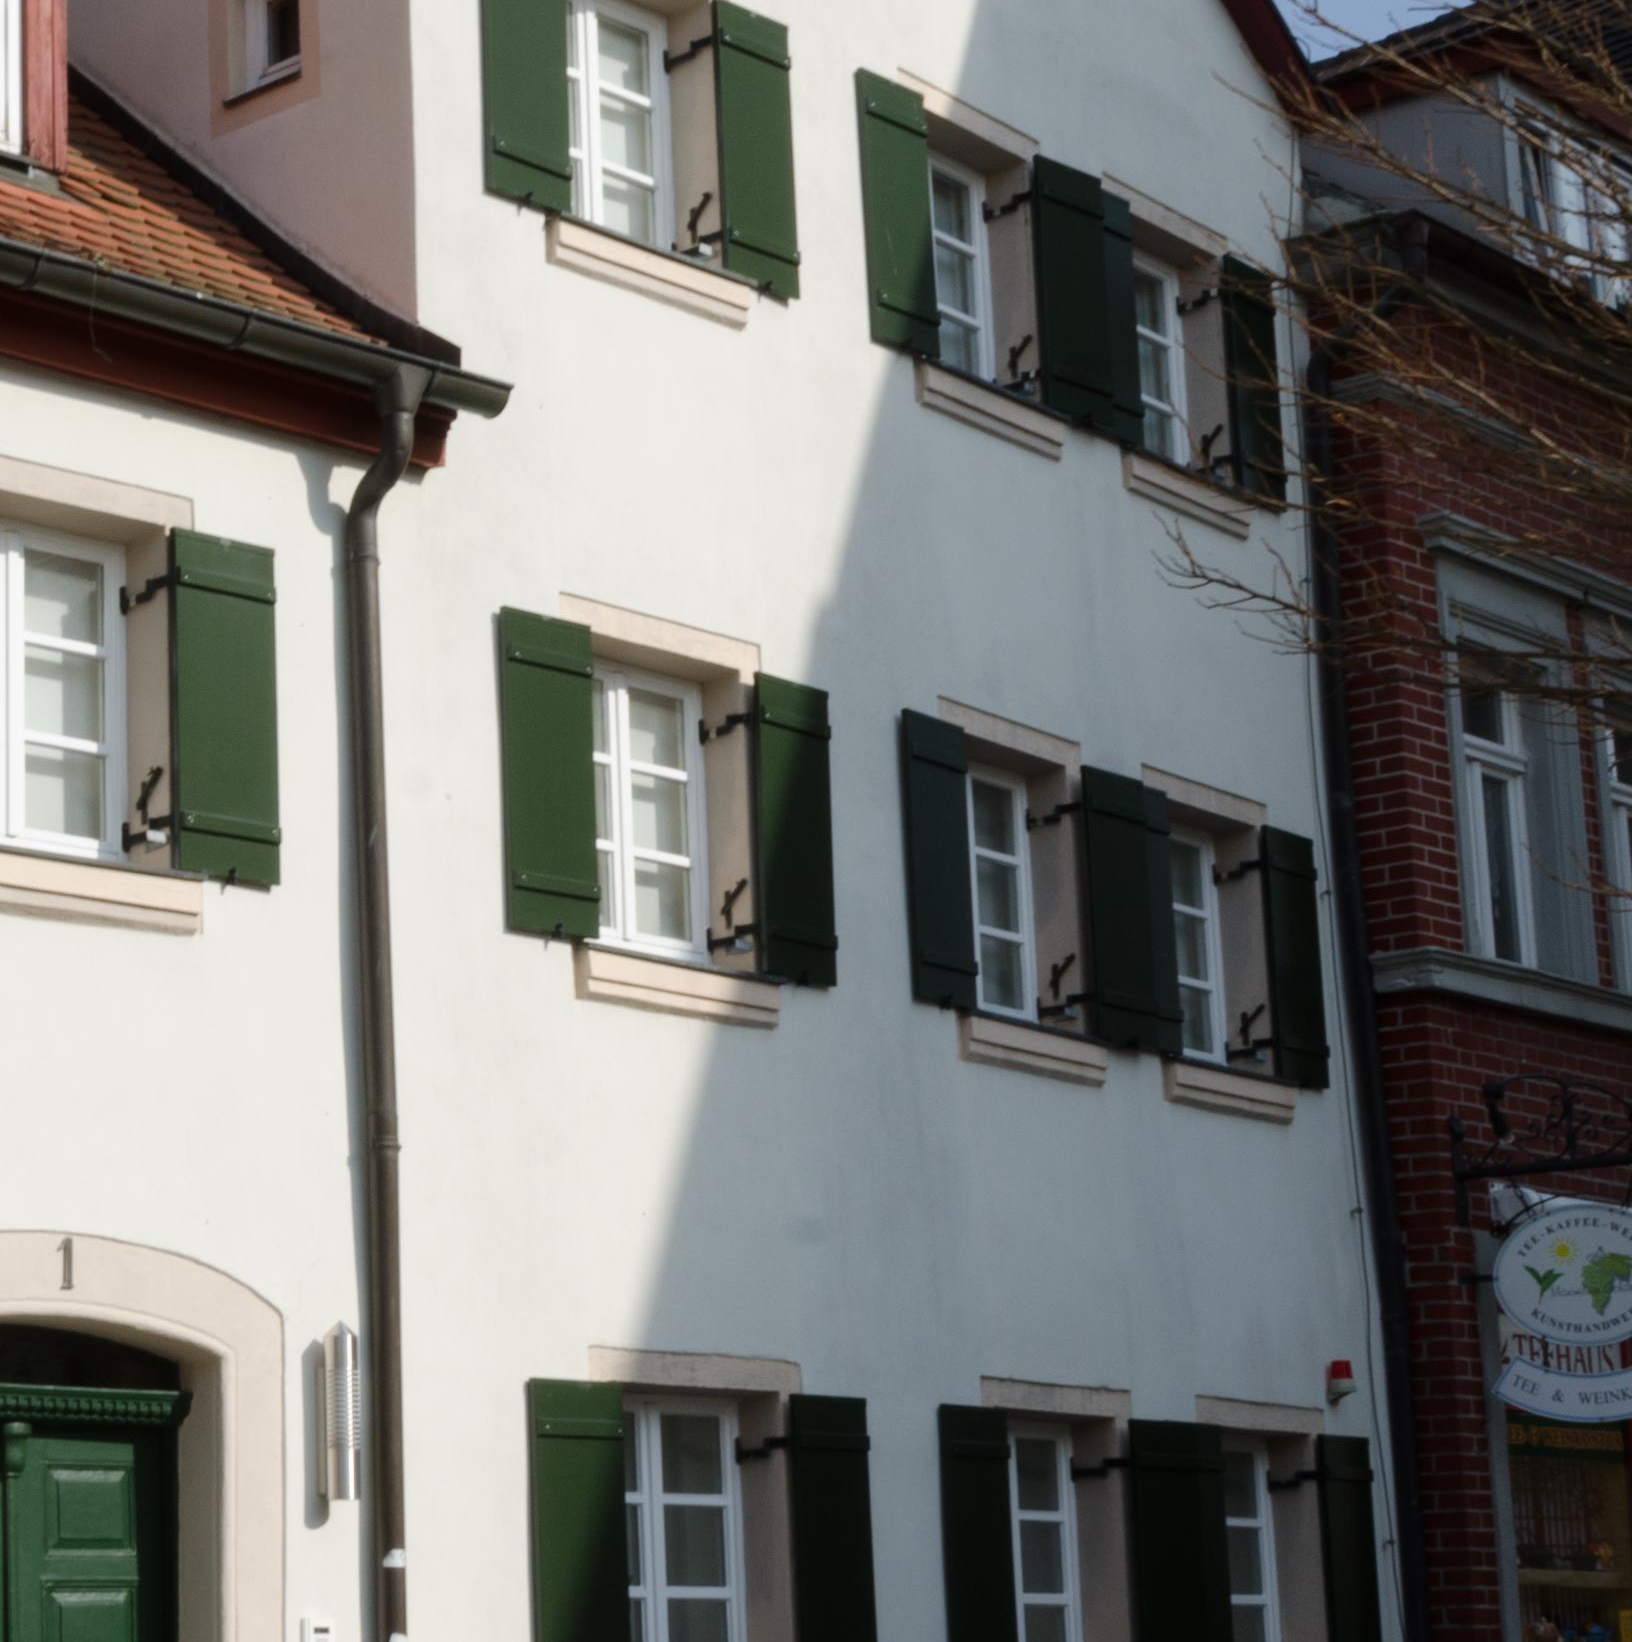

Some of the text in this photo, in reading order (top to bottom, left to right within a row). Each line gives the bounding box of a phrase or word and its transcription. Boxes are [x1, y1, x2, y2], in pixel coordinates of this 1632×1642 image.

[1517, 1216, 1632, 1258] TEE-KAFFEE-WE
[1513, 1373, 1543, 1396] TEE
[1552, 1388, 1565, 1403] &
